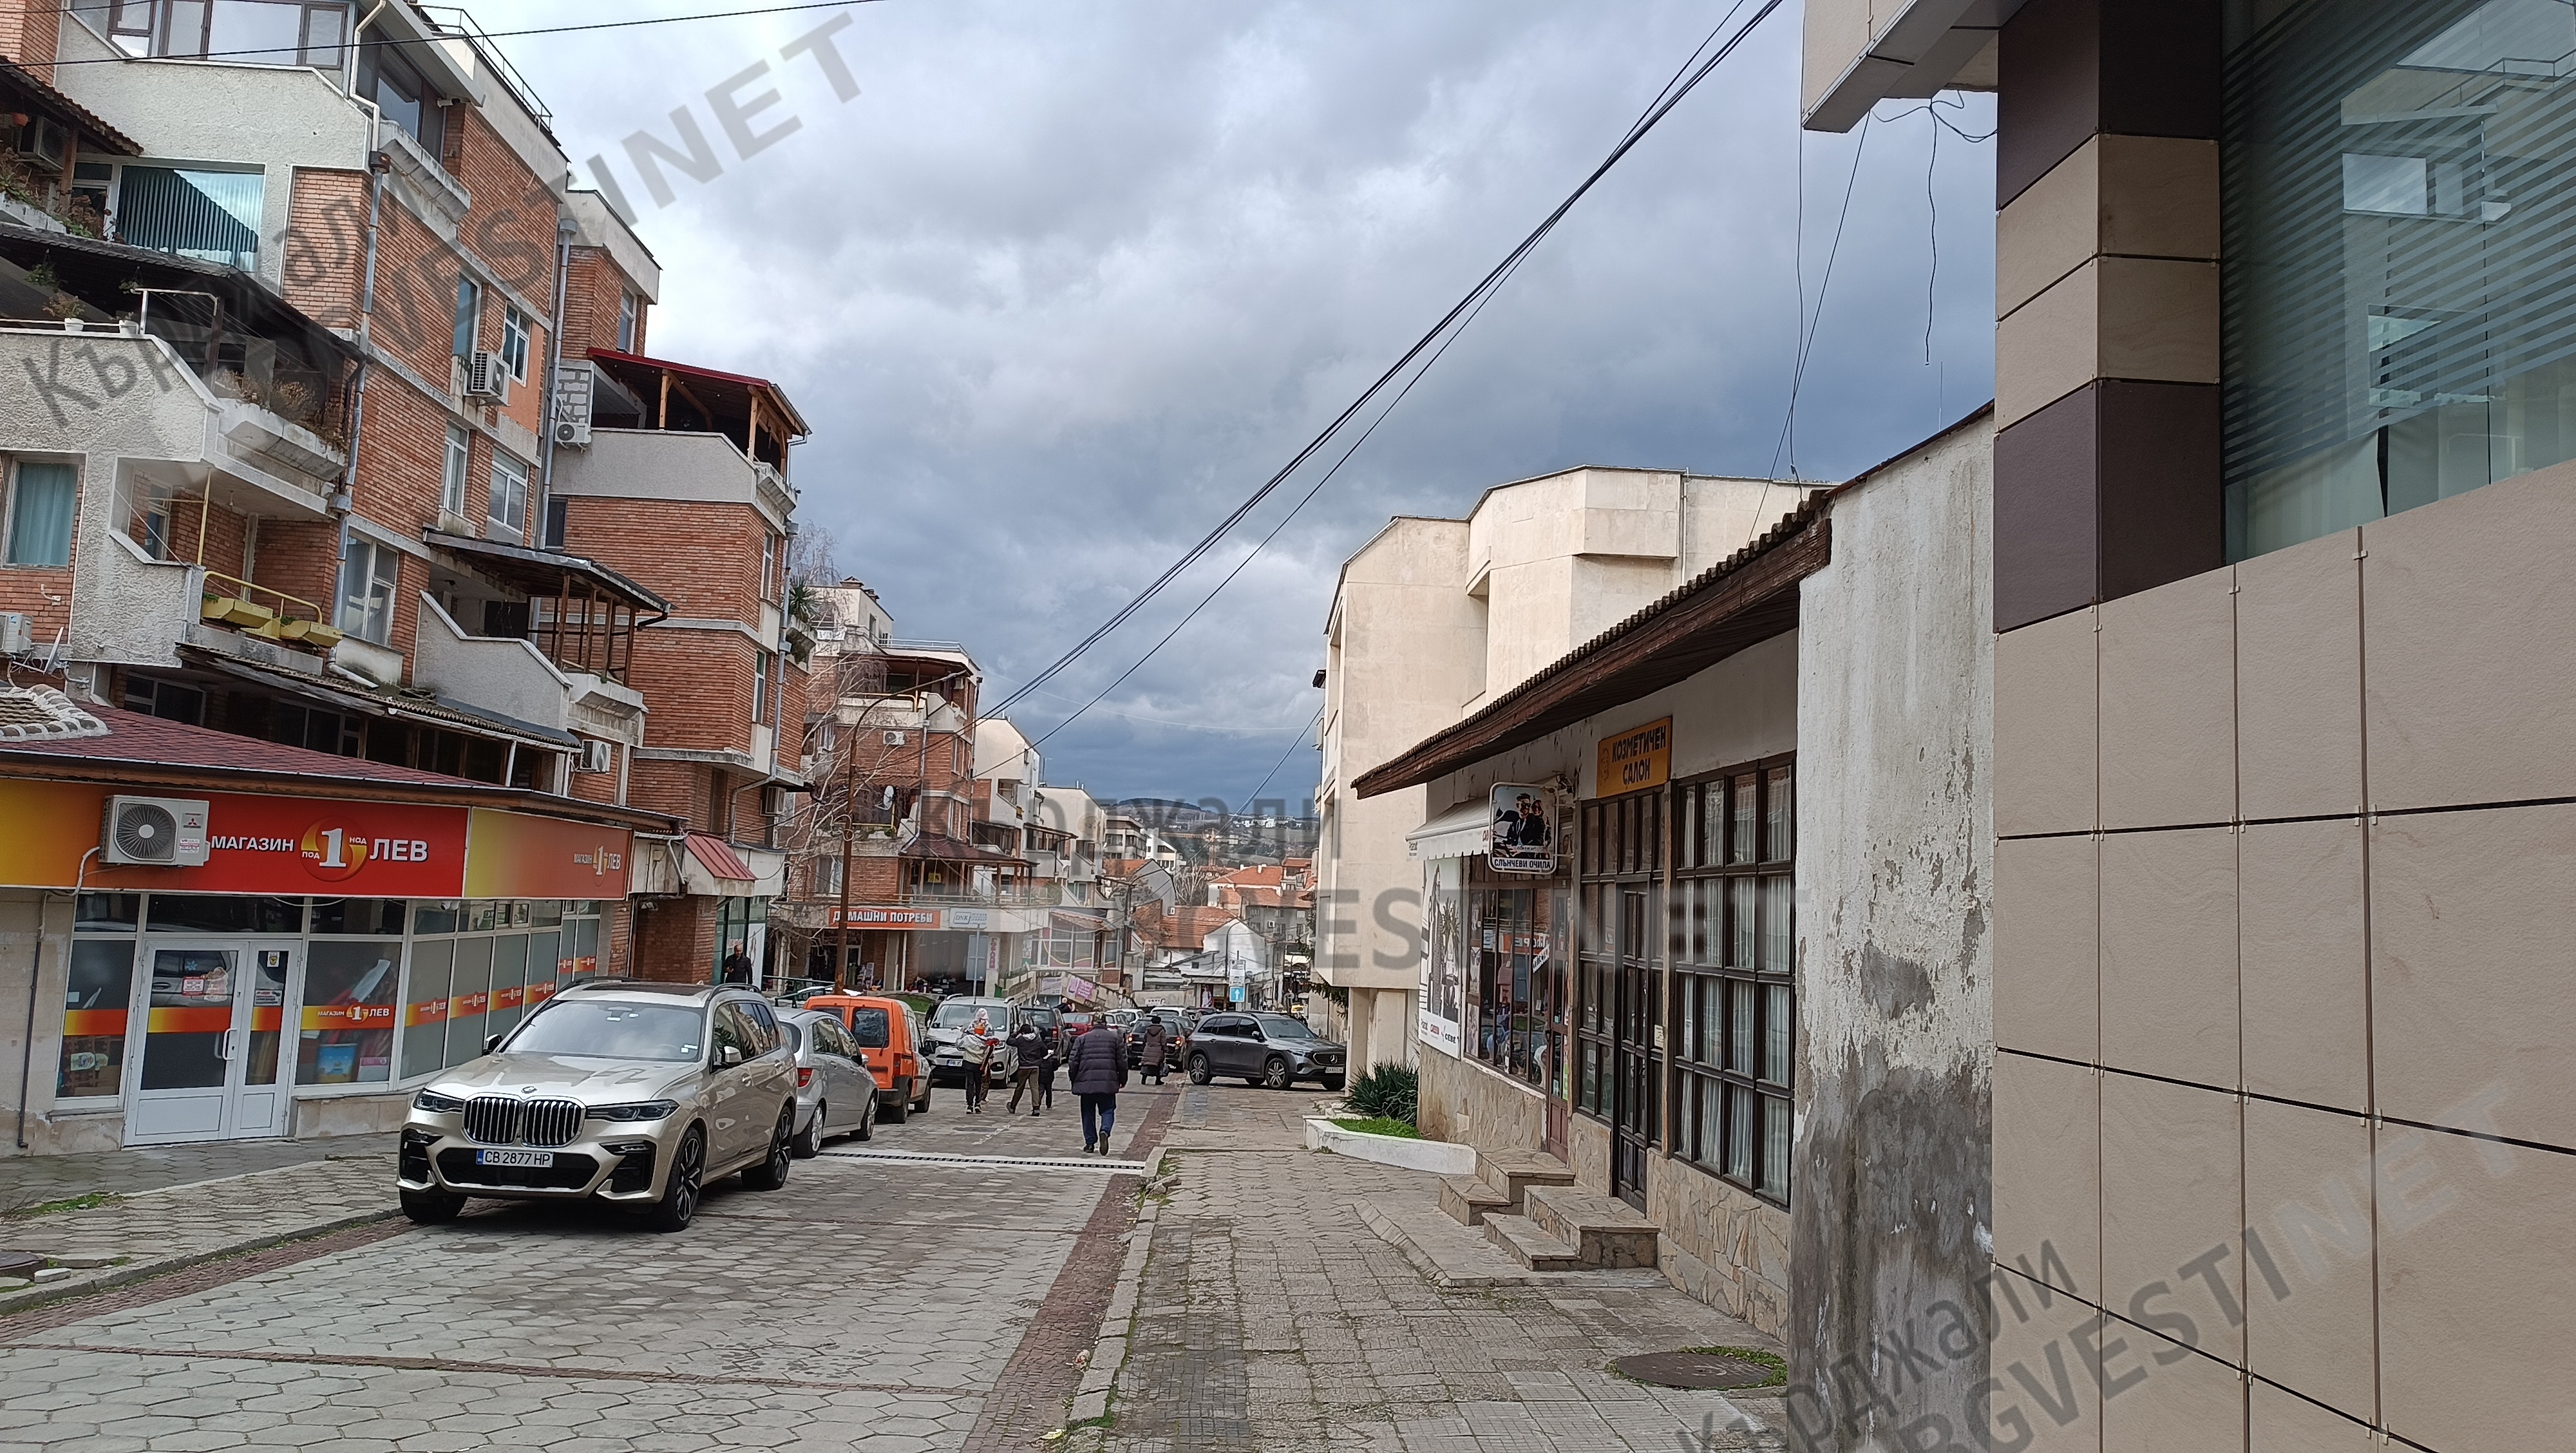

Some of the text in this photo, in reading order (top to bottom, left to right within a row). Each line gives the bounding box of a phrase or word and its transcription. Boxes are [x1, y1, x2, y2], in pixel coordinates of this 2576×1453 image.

[1611, 725, 1667, 763] КОЗМЕТИЧЕН
[1623, 757, 1651, 785] САЛОН
[211, 835, 295, 852] МАГАЗИН
[319, 828, 346, 868] 1
[369, 838, 428, 862] ЛЕВ
[1494, 859, 1551, 869] СЛЪНЧЕВИ ОЧИЛА
[832, 911, 933, 924] ДМАШНИ ПОТРЕБИ
[368, 1008, 390, 1017] ЛЕВ
[485, 1151, 551, 1166] CB 2877 HP
